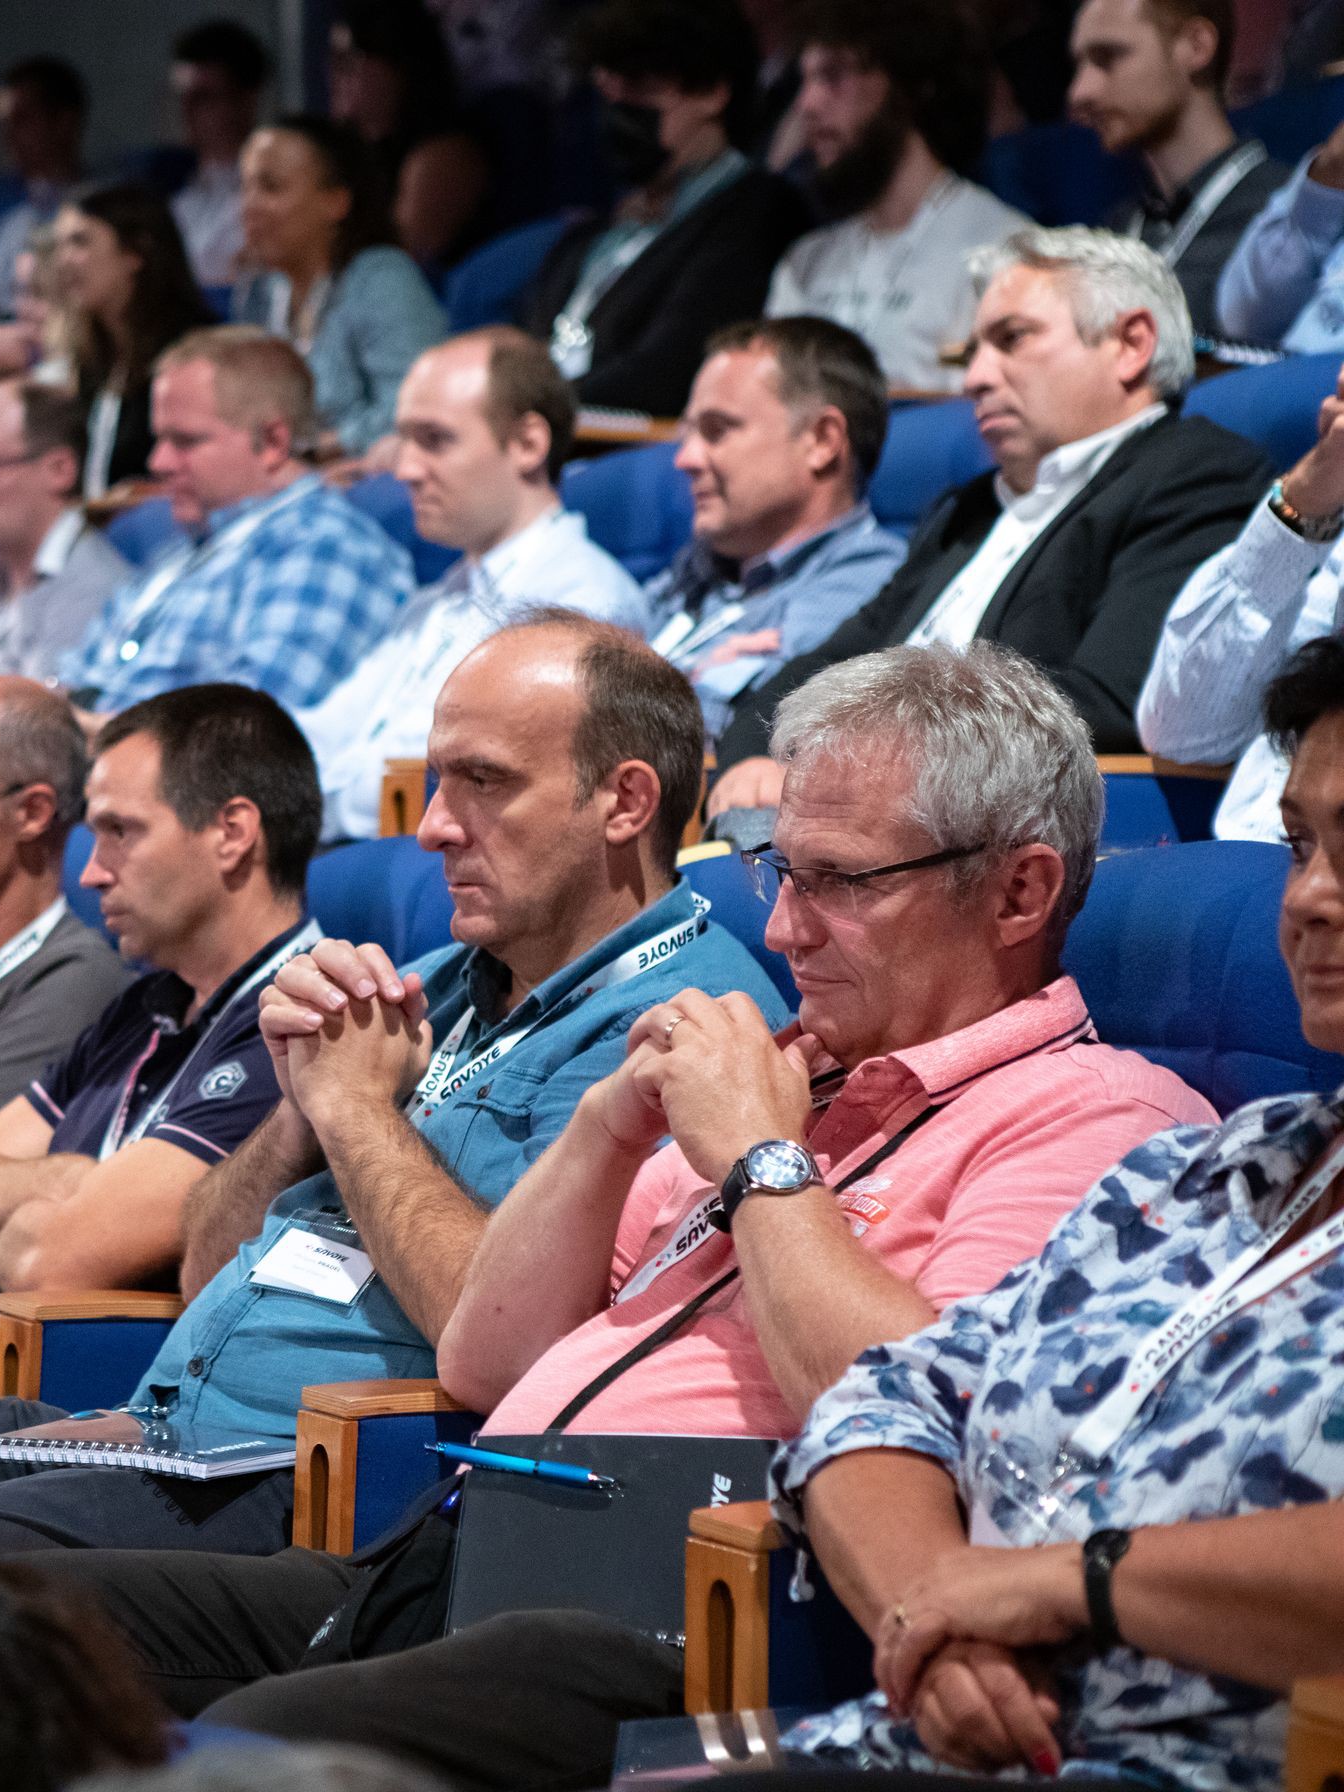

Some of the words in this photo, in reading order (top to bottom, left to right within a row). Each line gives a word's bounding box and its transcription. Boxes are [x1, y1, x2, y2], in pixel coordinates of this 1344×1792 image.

[638, 926, 695, 970] SAVOYE
[439, 1045, 501, 1100] SAVOYE
[1153, 1295, 1241, 1370] SAVOYE
